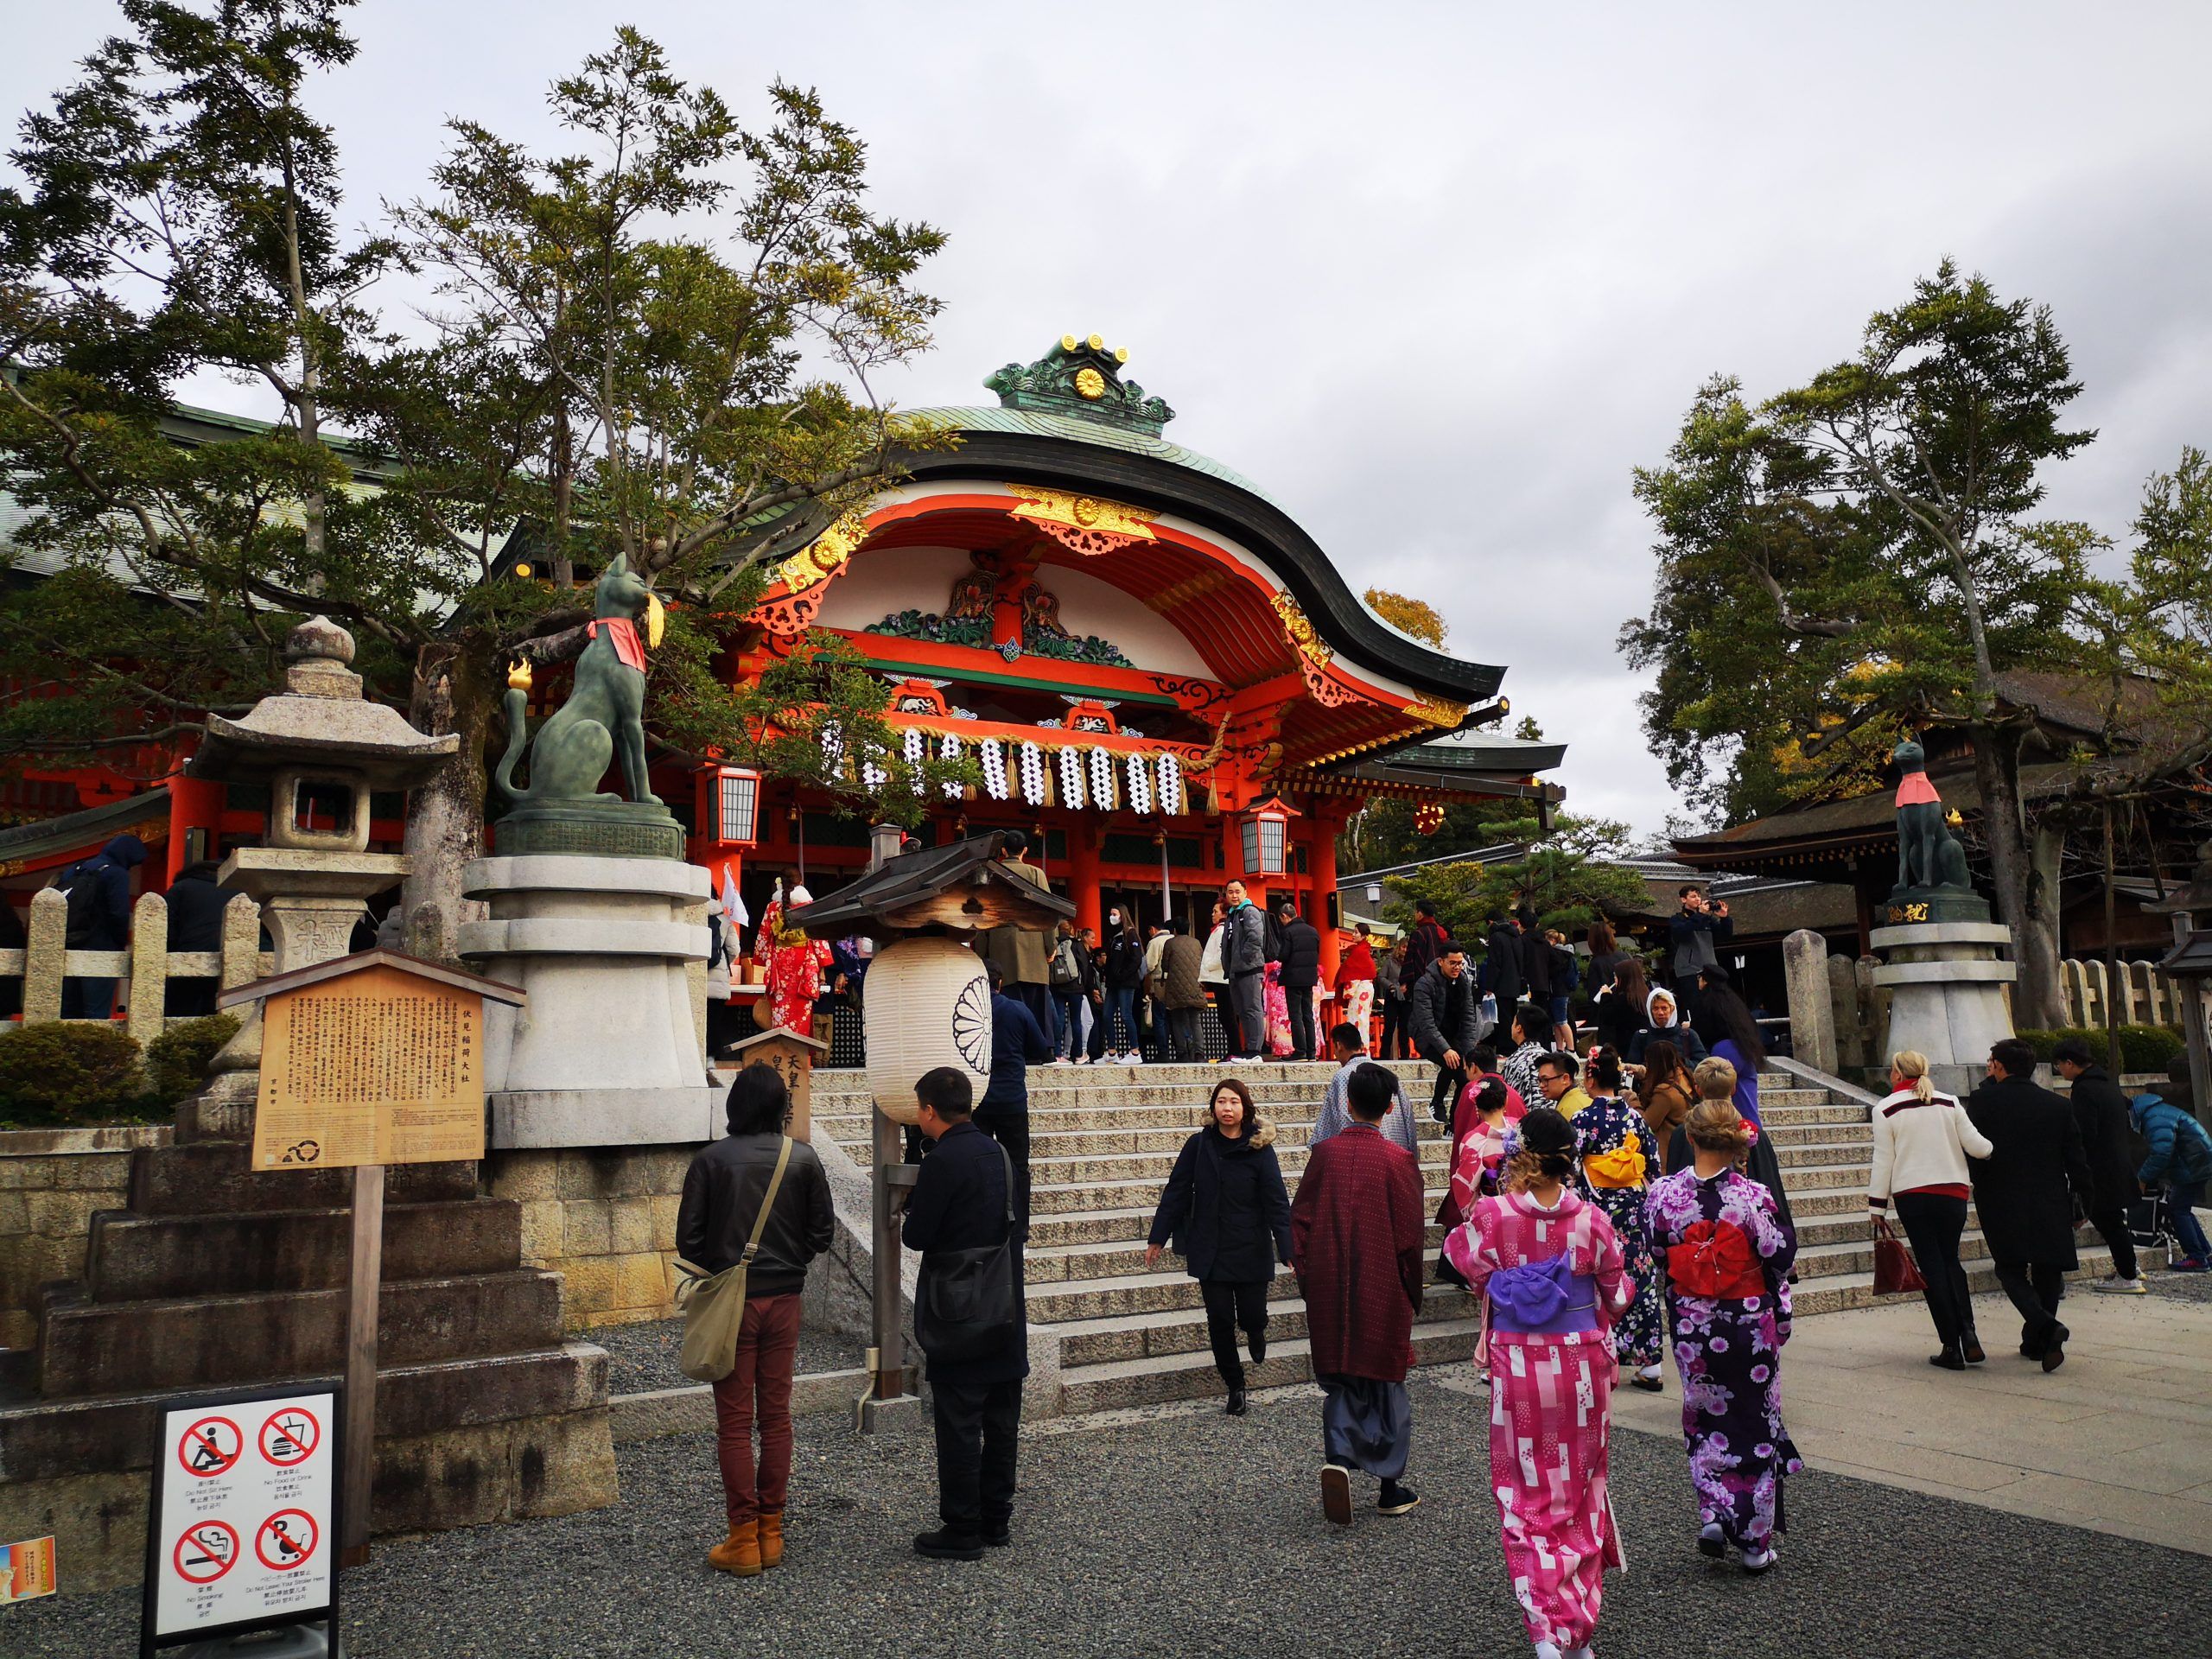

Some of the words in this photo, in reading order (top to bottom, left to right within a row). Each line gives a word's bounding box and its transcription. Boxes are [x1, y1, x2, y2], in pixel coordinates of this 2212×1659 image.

[461, 1010, 472, 1083] 伏見稲荷大社
